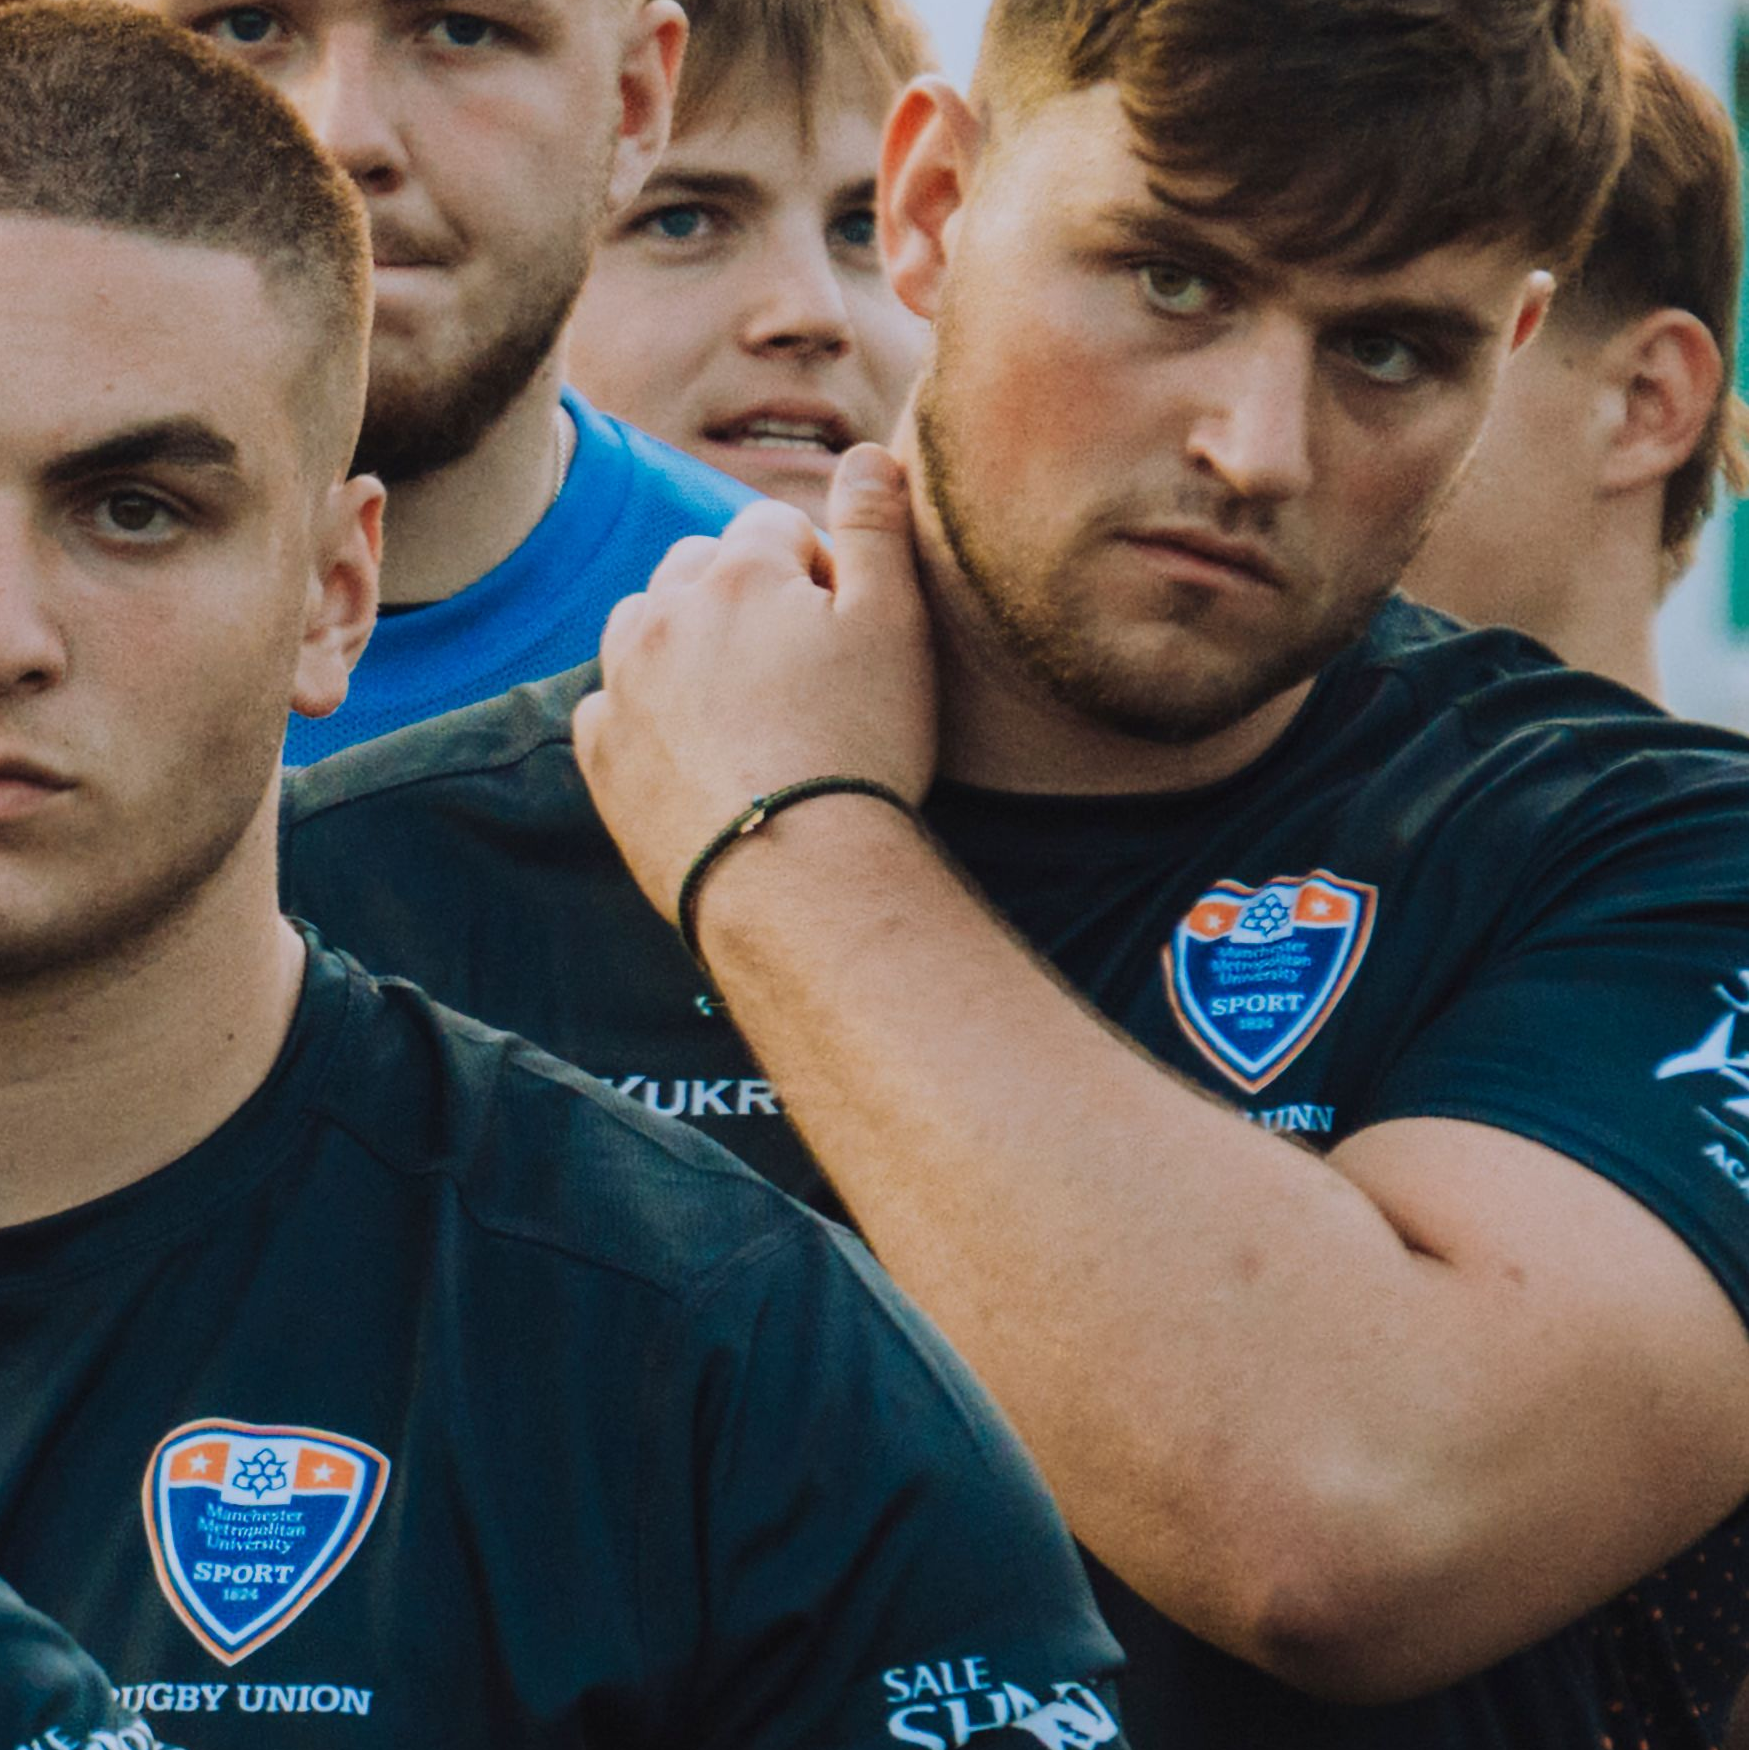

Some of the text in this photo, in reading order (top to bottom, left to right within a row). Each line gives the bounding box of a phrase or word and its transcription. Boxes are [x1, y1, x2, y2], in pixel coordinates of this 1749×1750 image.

[1210, 991, 1306, 1016] SPORT
[206, 1501, 303, 1522] Manchester
[197, 1515, 306, 1538] Metropolitan
[206, 1533, 293, 1555] University
[193, 1561, 295, 1584] SPORT
[882, 1657, 993, 1704] SALE
[239, 1684, 373, 1716] UNION
